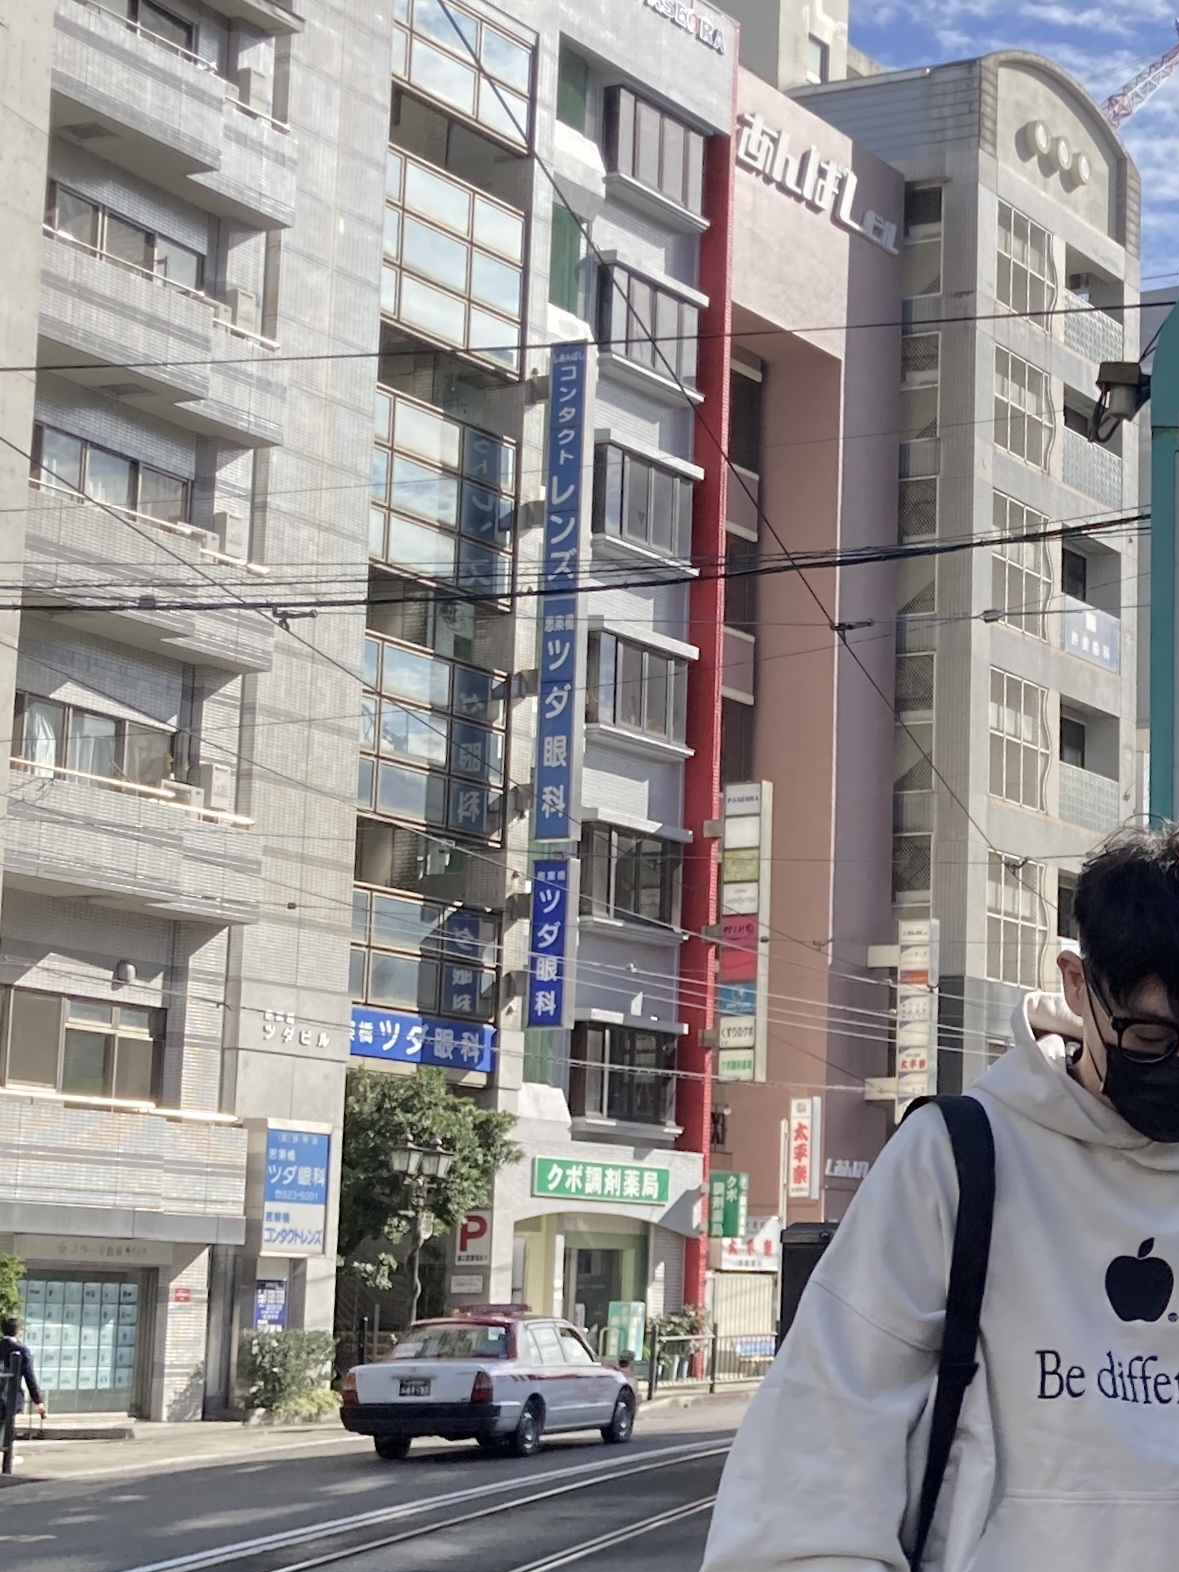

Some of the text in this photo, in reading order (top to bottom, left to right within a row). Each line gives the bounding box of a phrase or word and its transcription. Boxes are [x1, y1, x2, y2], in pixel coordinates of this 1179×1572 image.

[542, 639, 571, 820] ツダ眼科
[534, 889, 562, 1017] ツダ眼科
[263, 1024, 331, 1049] ツダビル
[380, 1020, 480, 1064] ツダ眼科
[268, 1164, 325, 1187] ツダ眼科
[547, 1164, 660, 1199] クボ調剤薬局
[264, 1228, 322, 1245] コンタクトレンズ
[459, 1215, 488, 1252] P
[1035, 1350, 1085, 1399] Be
